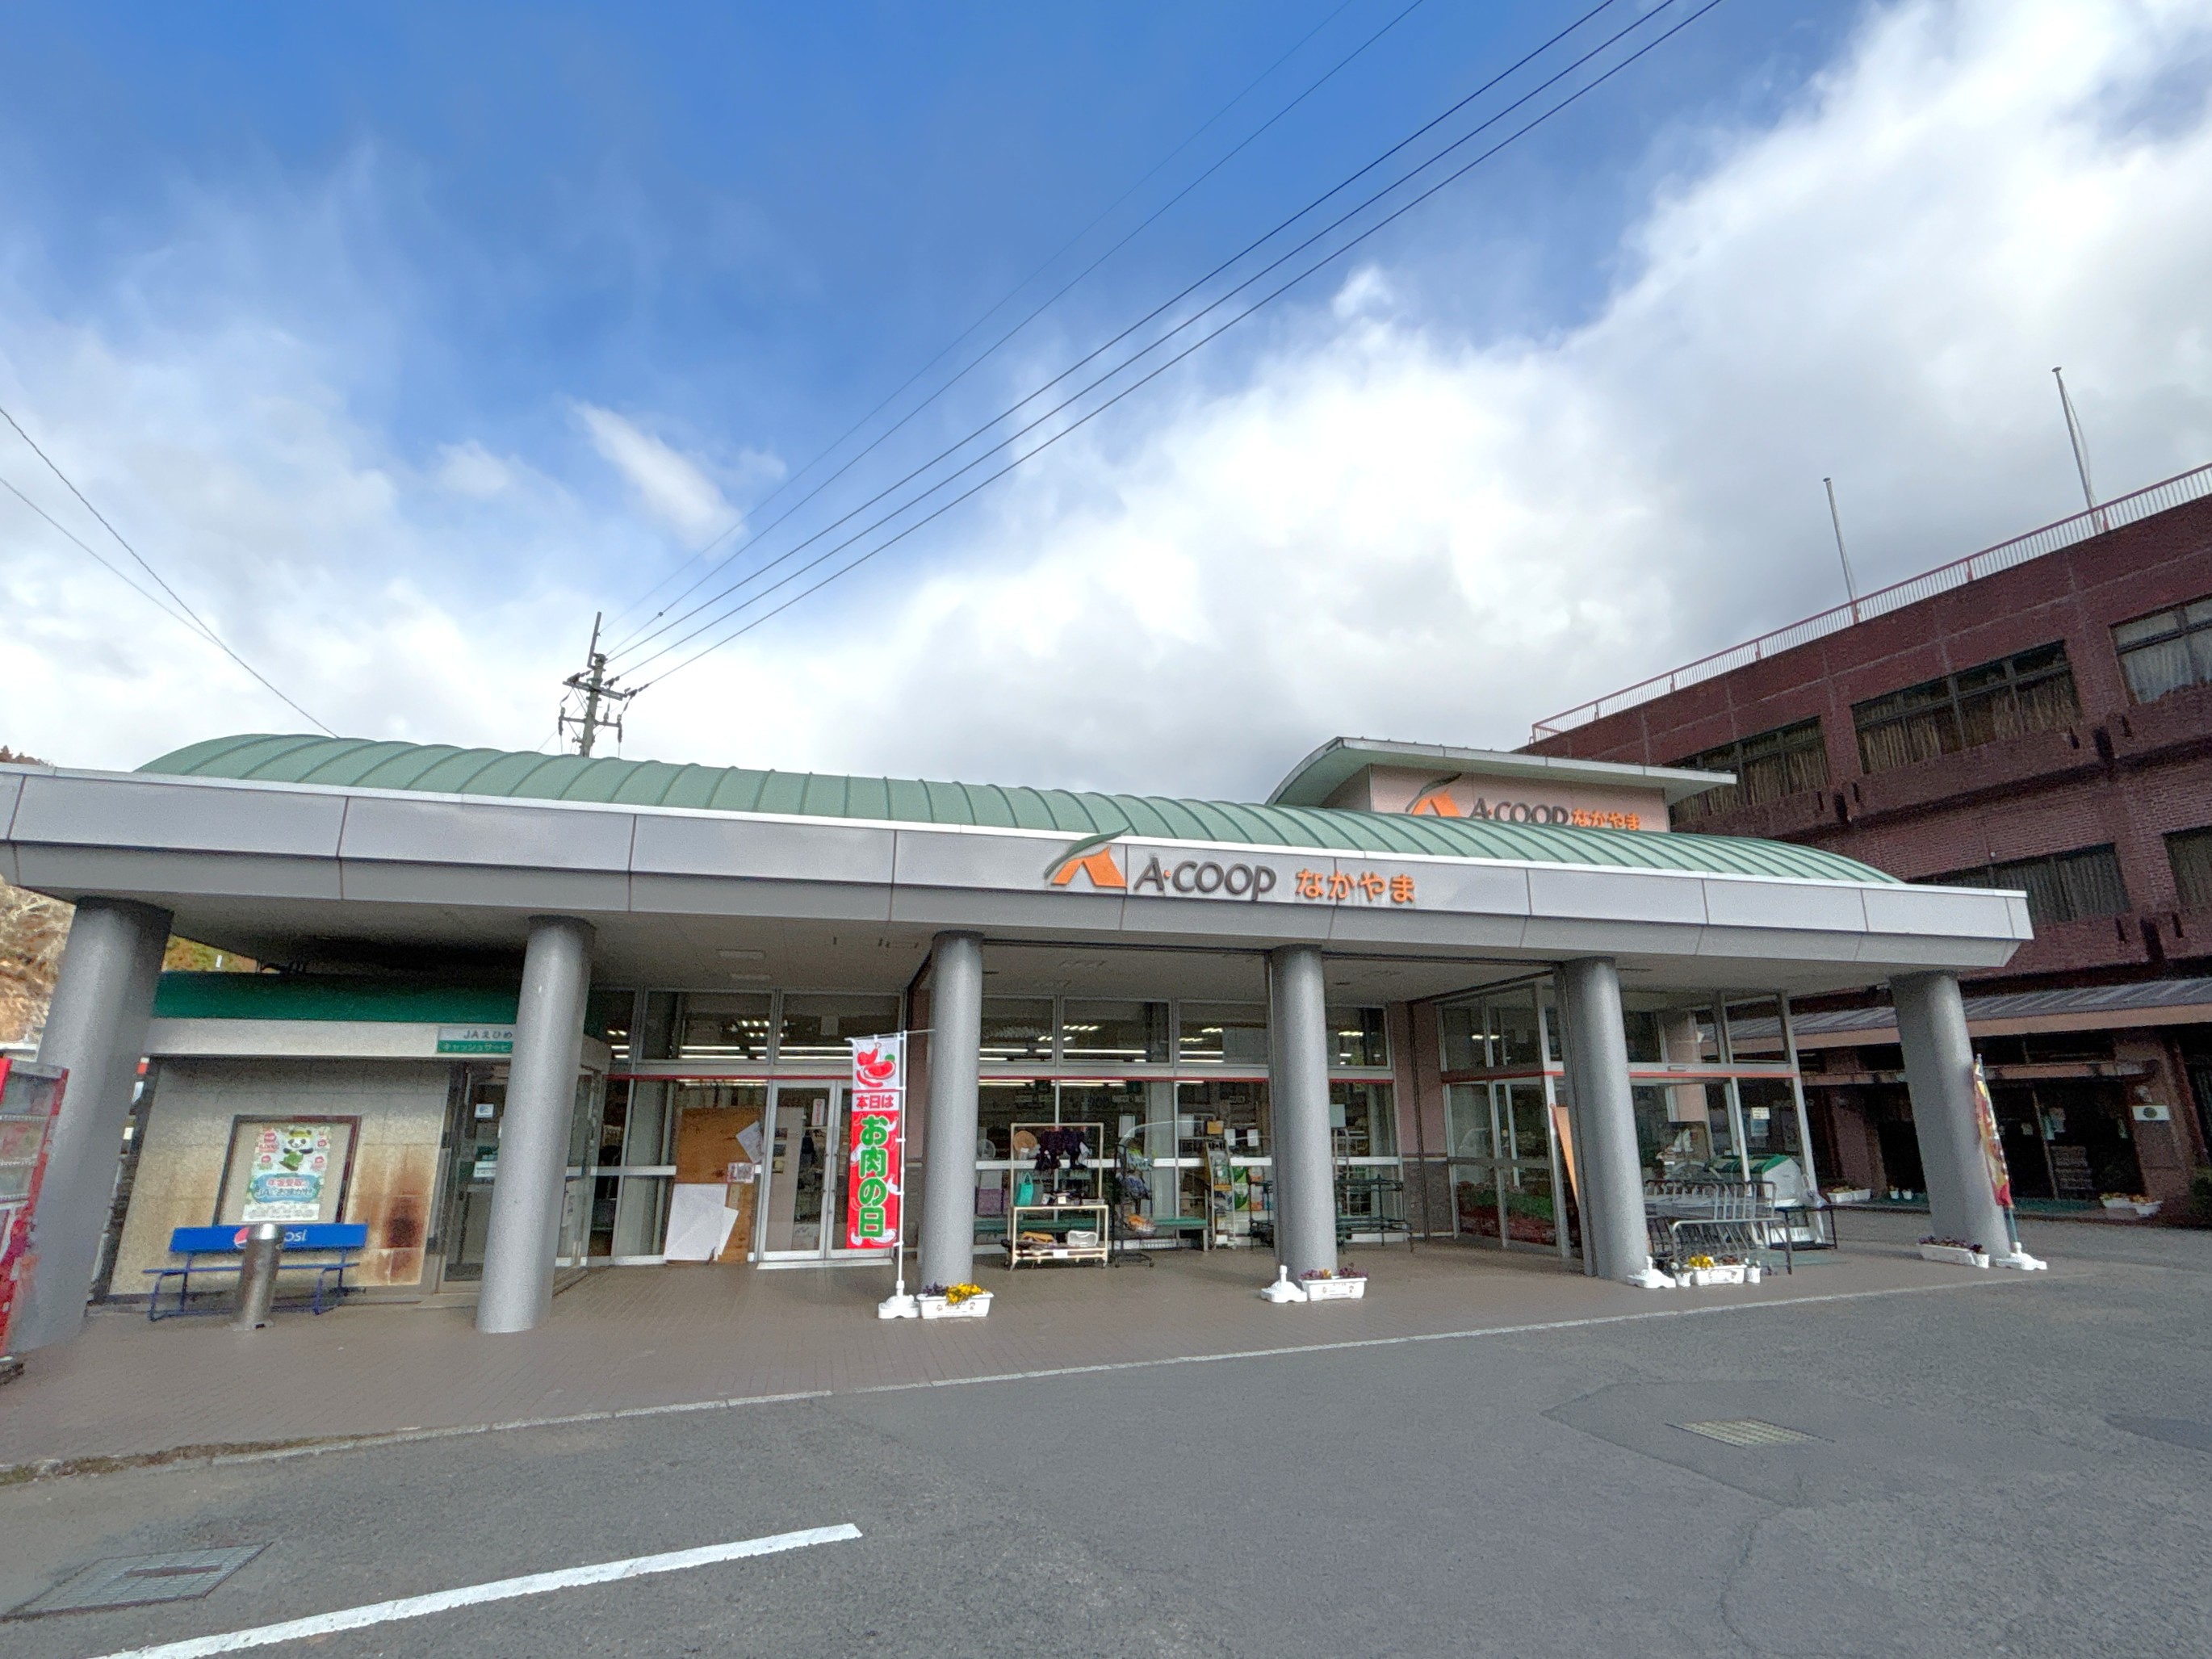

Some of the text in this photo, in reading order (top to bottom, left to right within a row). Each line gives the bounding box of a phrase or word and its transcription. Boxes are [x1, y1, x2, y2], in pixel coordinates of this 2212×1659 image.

[1572, 807, 1640, 832] なかやま
[1295, 868, 1415, 905] なかやま
[856, 1094, 894, 1110] 本日は
[857, 1114, 889, 1238] お肉の日
